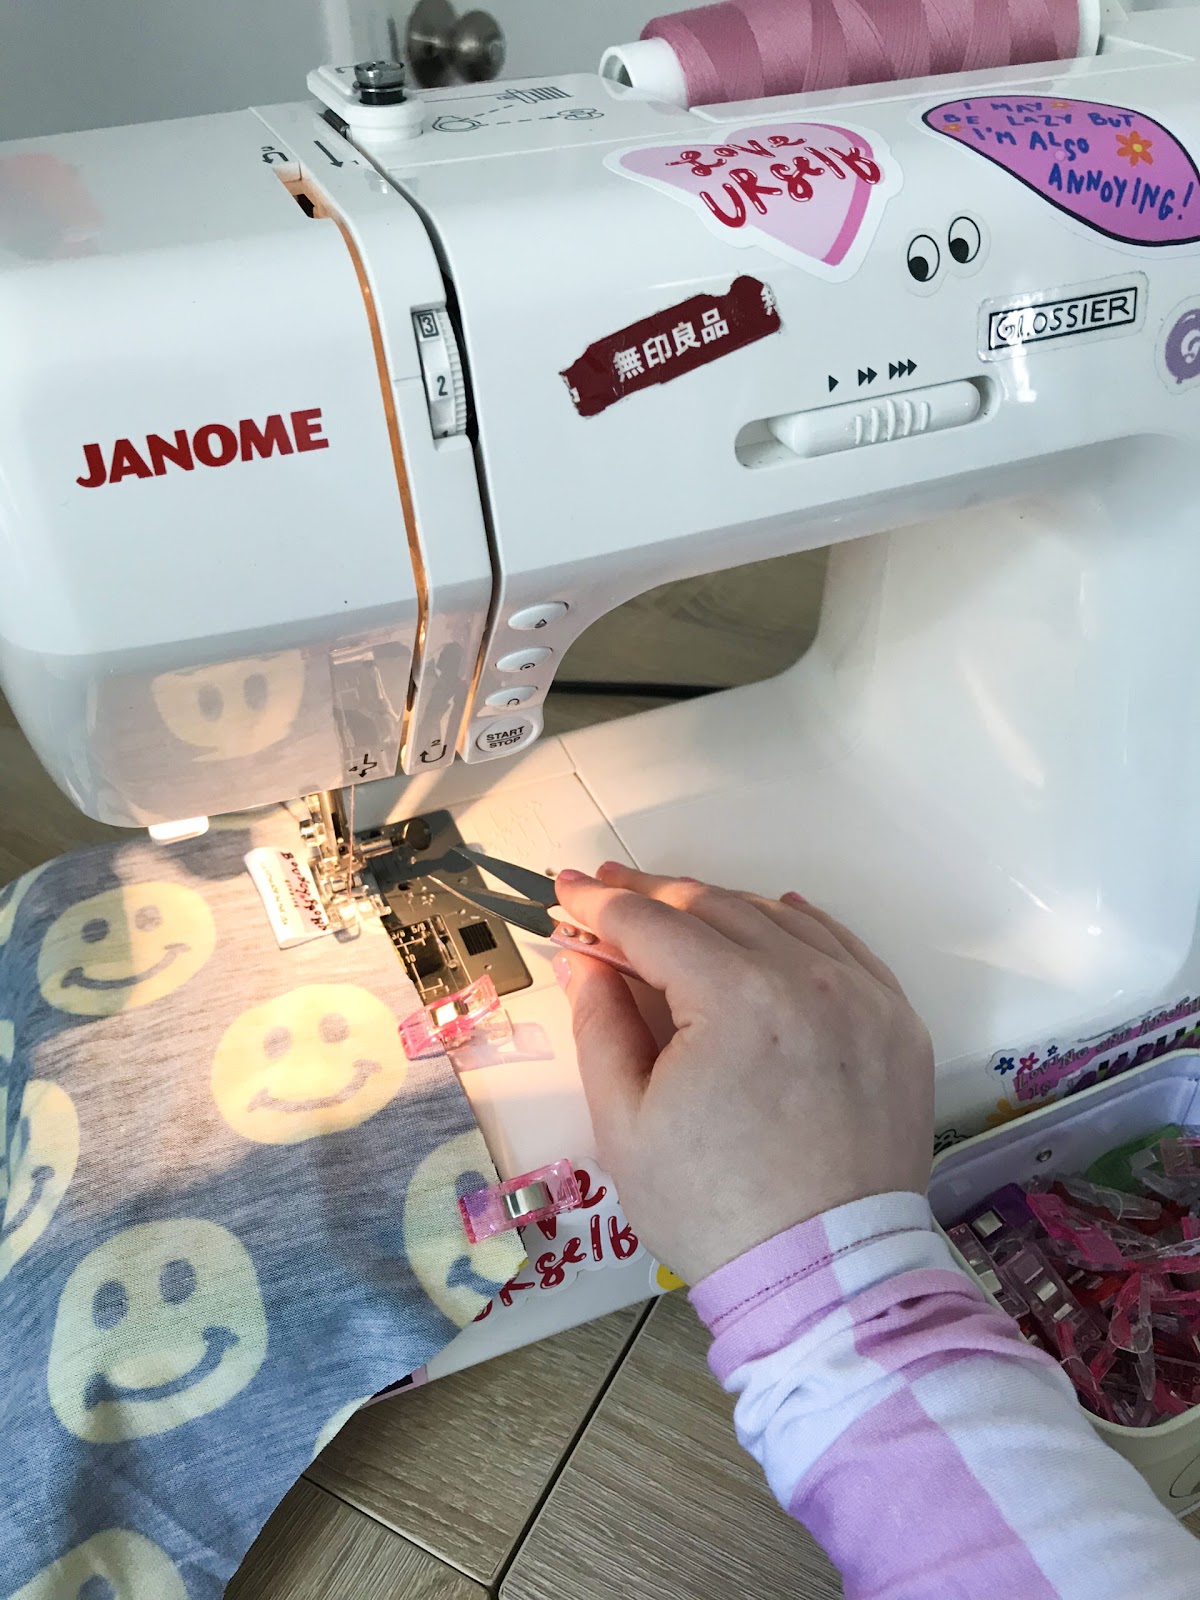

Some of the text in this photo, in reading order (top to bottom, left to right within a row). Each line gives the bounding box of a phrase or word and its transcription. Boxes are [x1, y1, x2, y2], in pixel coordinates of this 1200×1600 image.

[990, 102, 1043, 113] MAY
[943, 112, 1136, 128] BE LAZY BUT
[972, 127, 1090, 162] I'M ALSO
[1048, 163, 1195, 220] ANNOYING!
[421, 315, 435, 335] 3
[997, 295, 1130, 341] GLOSSIER
[612, 307, 730, 383] 無印良品
[436, 374, 449, 397] 2
[76, 407, 330, 488] JANOME
[430, 739, 441, 748] 2
[486, 725, 525, 742] START
[489, 736, 521, 749] STOP
[404, 953, 417, 964] 10
